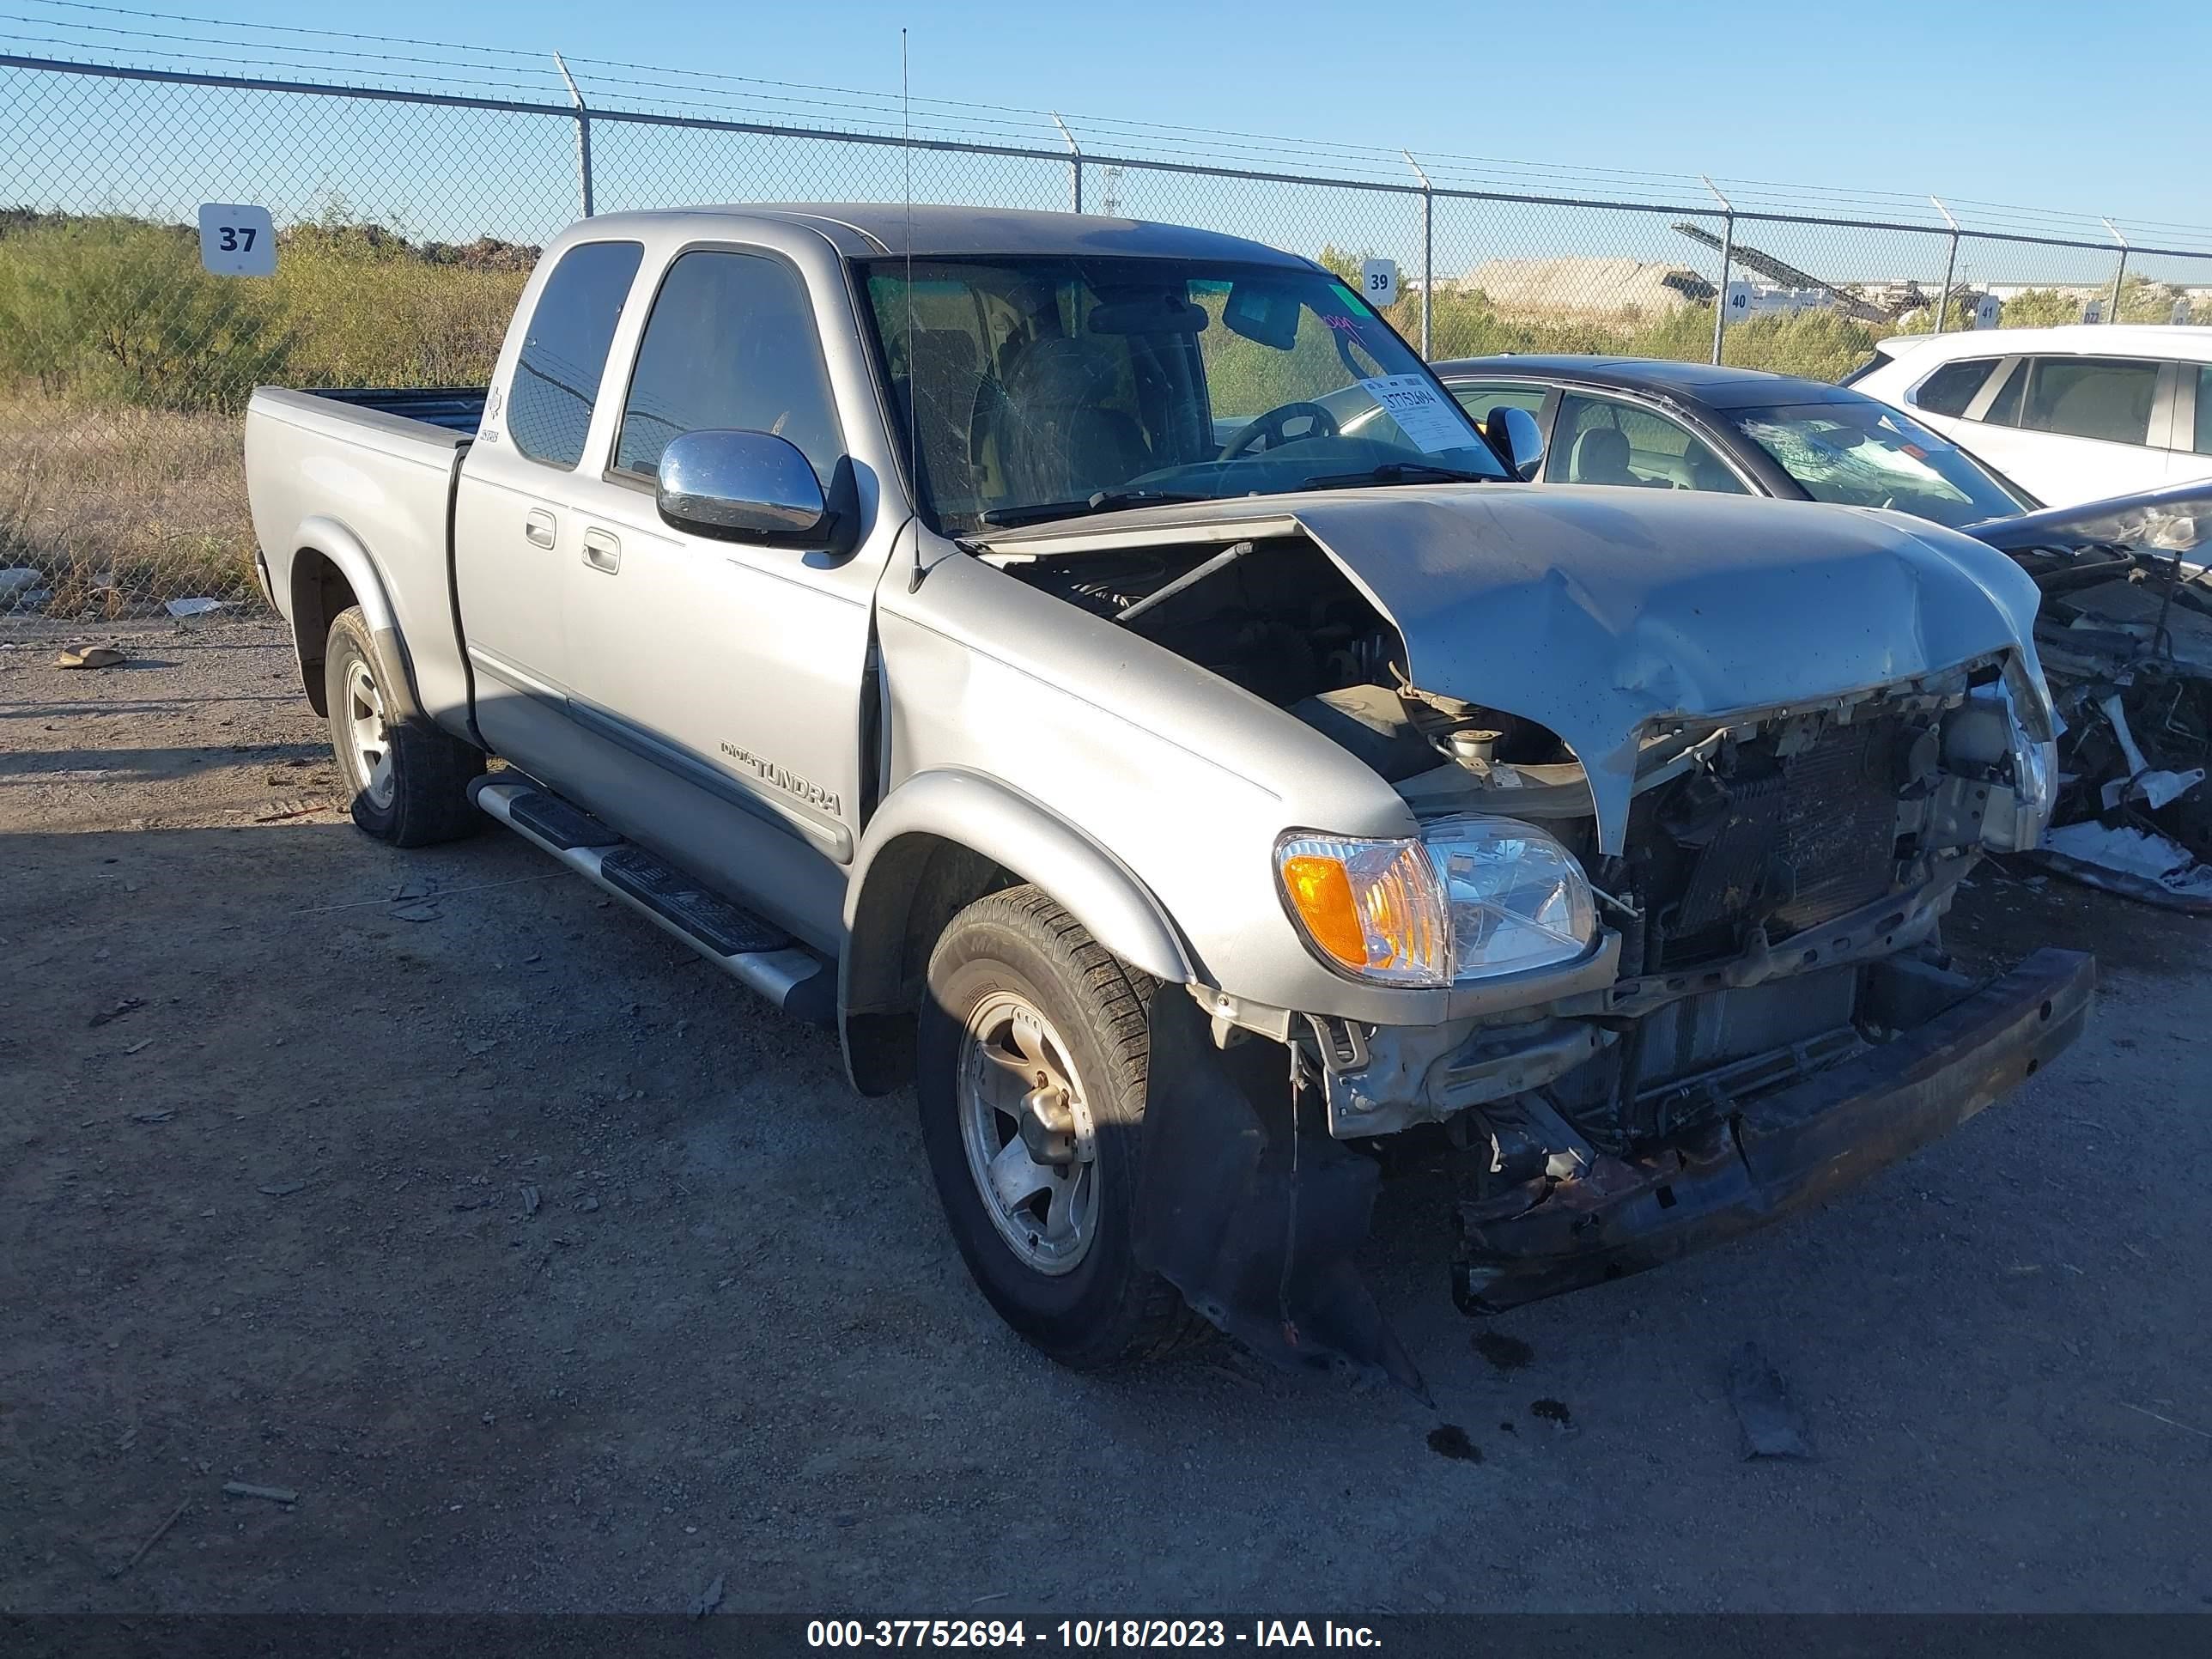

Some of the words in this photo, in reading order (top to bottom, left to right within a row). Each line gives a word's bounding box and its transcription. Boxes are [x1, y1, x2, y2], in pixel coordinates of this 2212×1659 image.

[219, 227, 257, 252] 37
[1370, 274, 1389, 290] 39
[1732, 295, 1746, 308] 40
[1982, 306, 1993, 319] 41
[1382, 390, 1437, 409] 37752694
[719, 740, 757, 767] TOYOTA
[755, 757, 842, 817] TUNDRA
